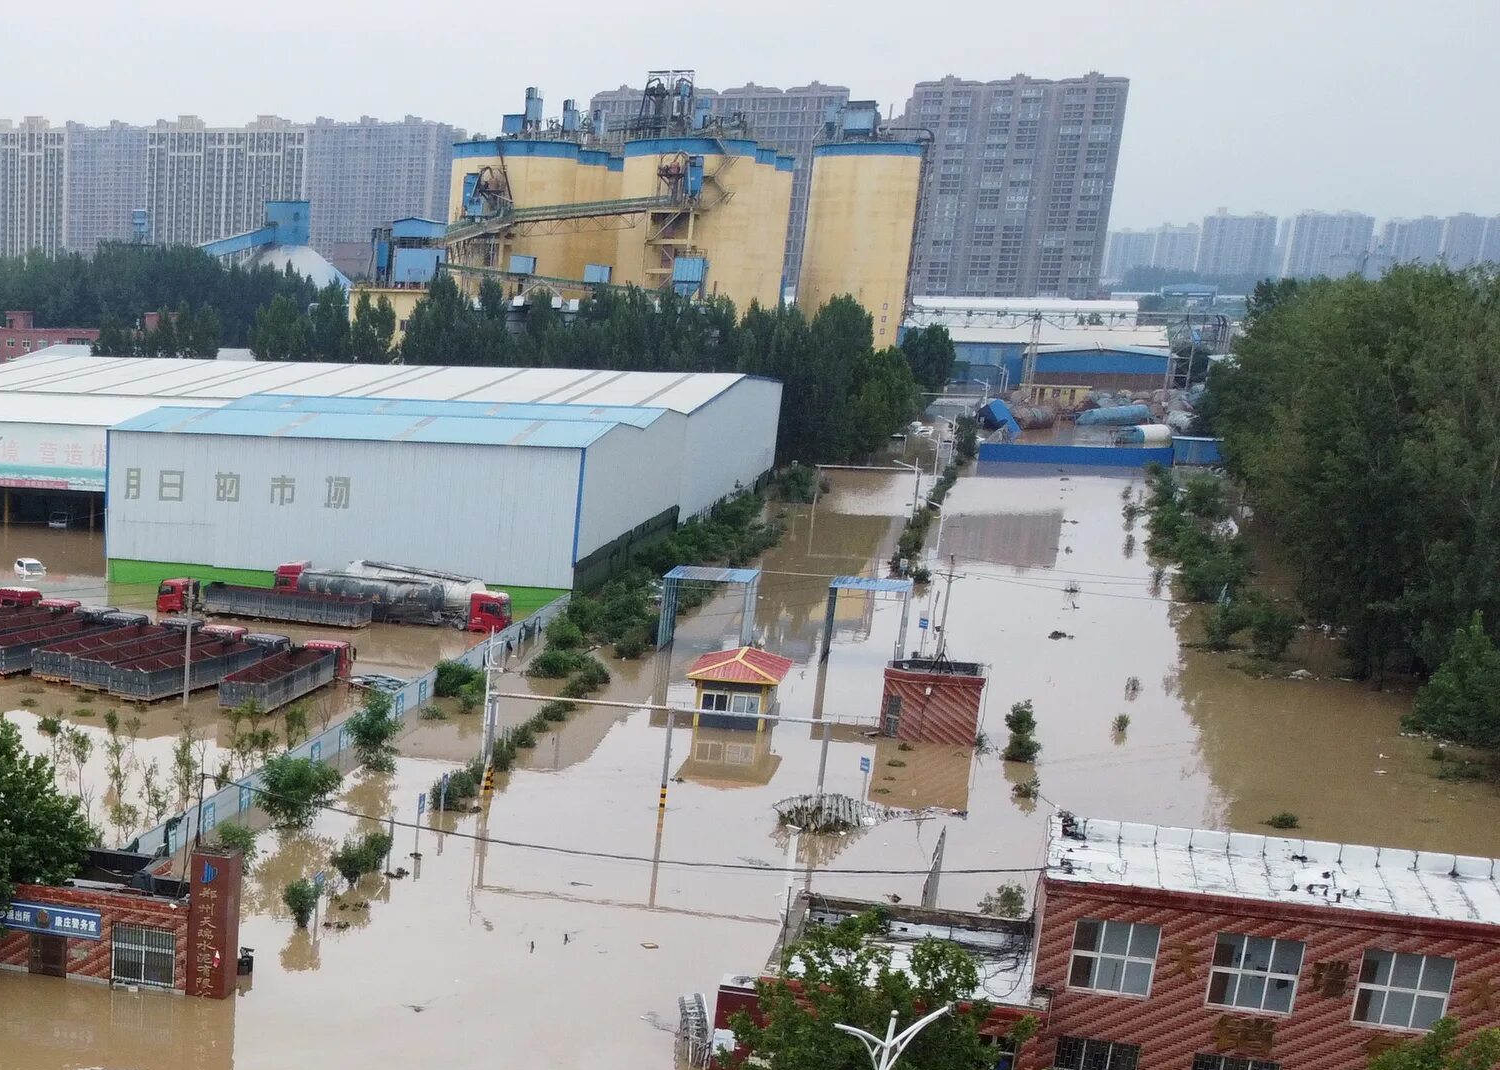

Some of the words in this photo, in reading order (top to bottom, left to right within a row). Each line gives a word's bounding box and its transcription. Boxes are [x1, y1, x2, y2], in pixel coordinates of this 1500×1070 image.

[54, 916, 97, 932] 康庄警务室
